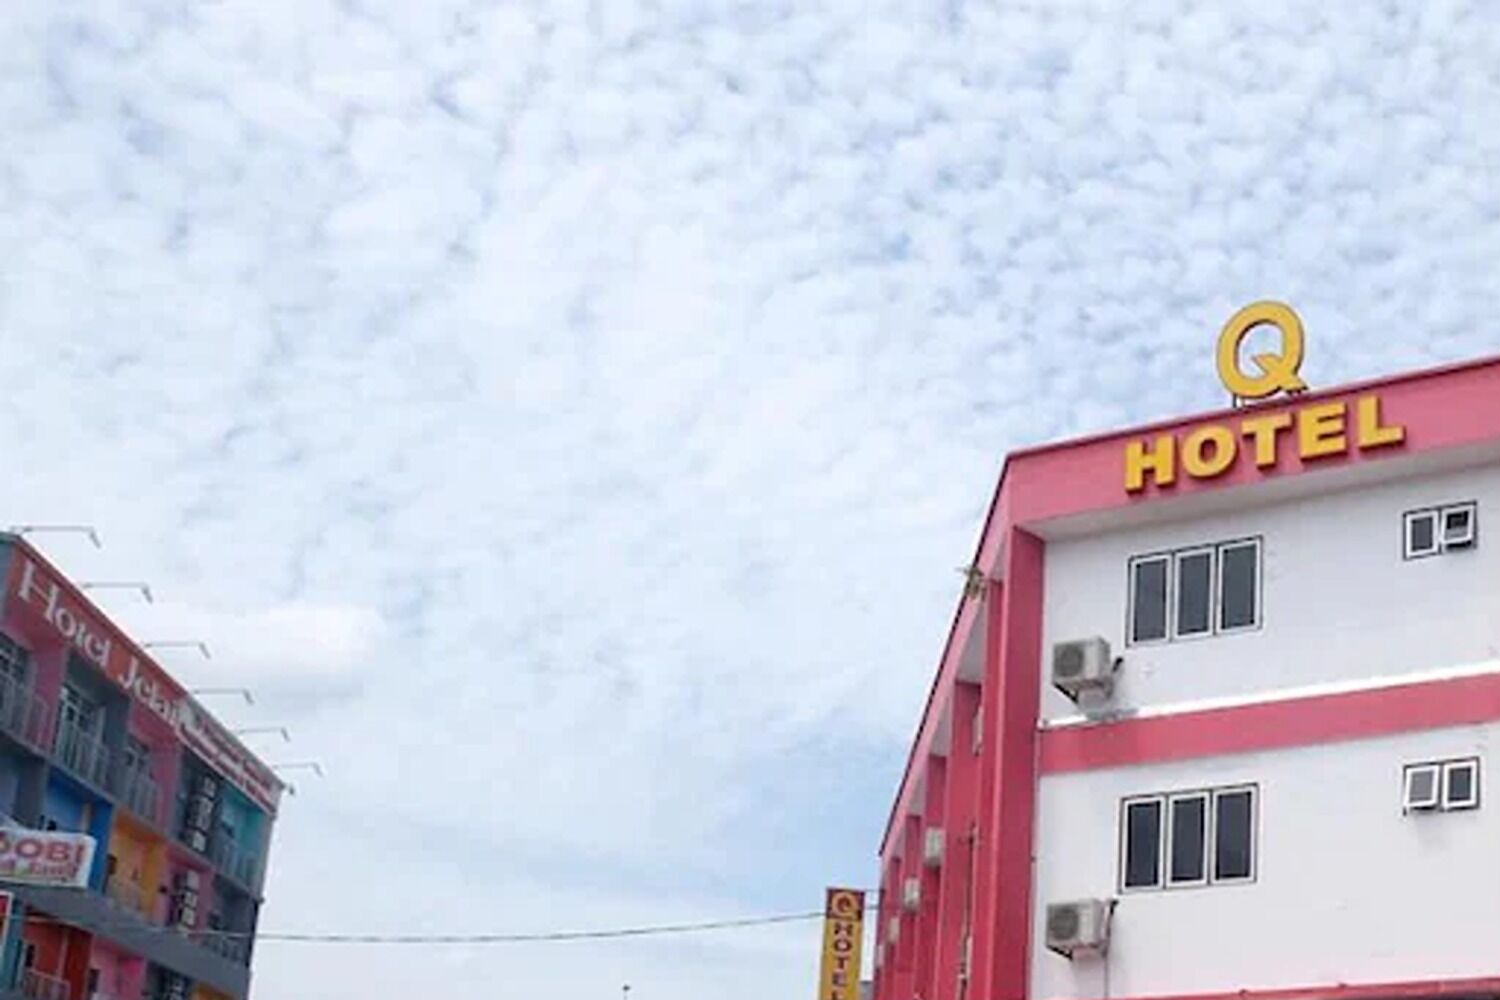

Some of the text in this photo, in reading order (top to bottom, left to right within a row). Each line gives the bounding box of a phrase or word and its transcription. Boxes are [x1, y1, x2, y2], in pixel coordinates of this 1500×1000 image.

[1218, 301, 1307, 398] Q
[1124, 395, 1406, 493] HOTEL
[18, 558, 112, 668] Hotel
[831, 892, 859, 918] Q
